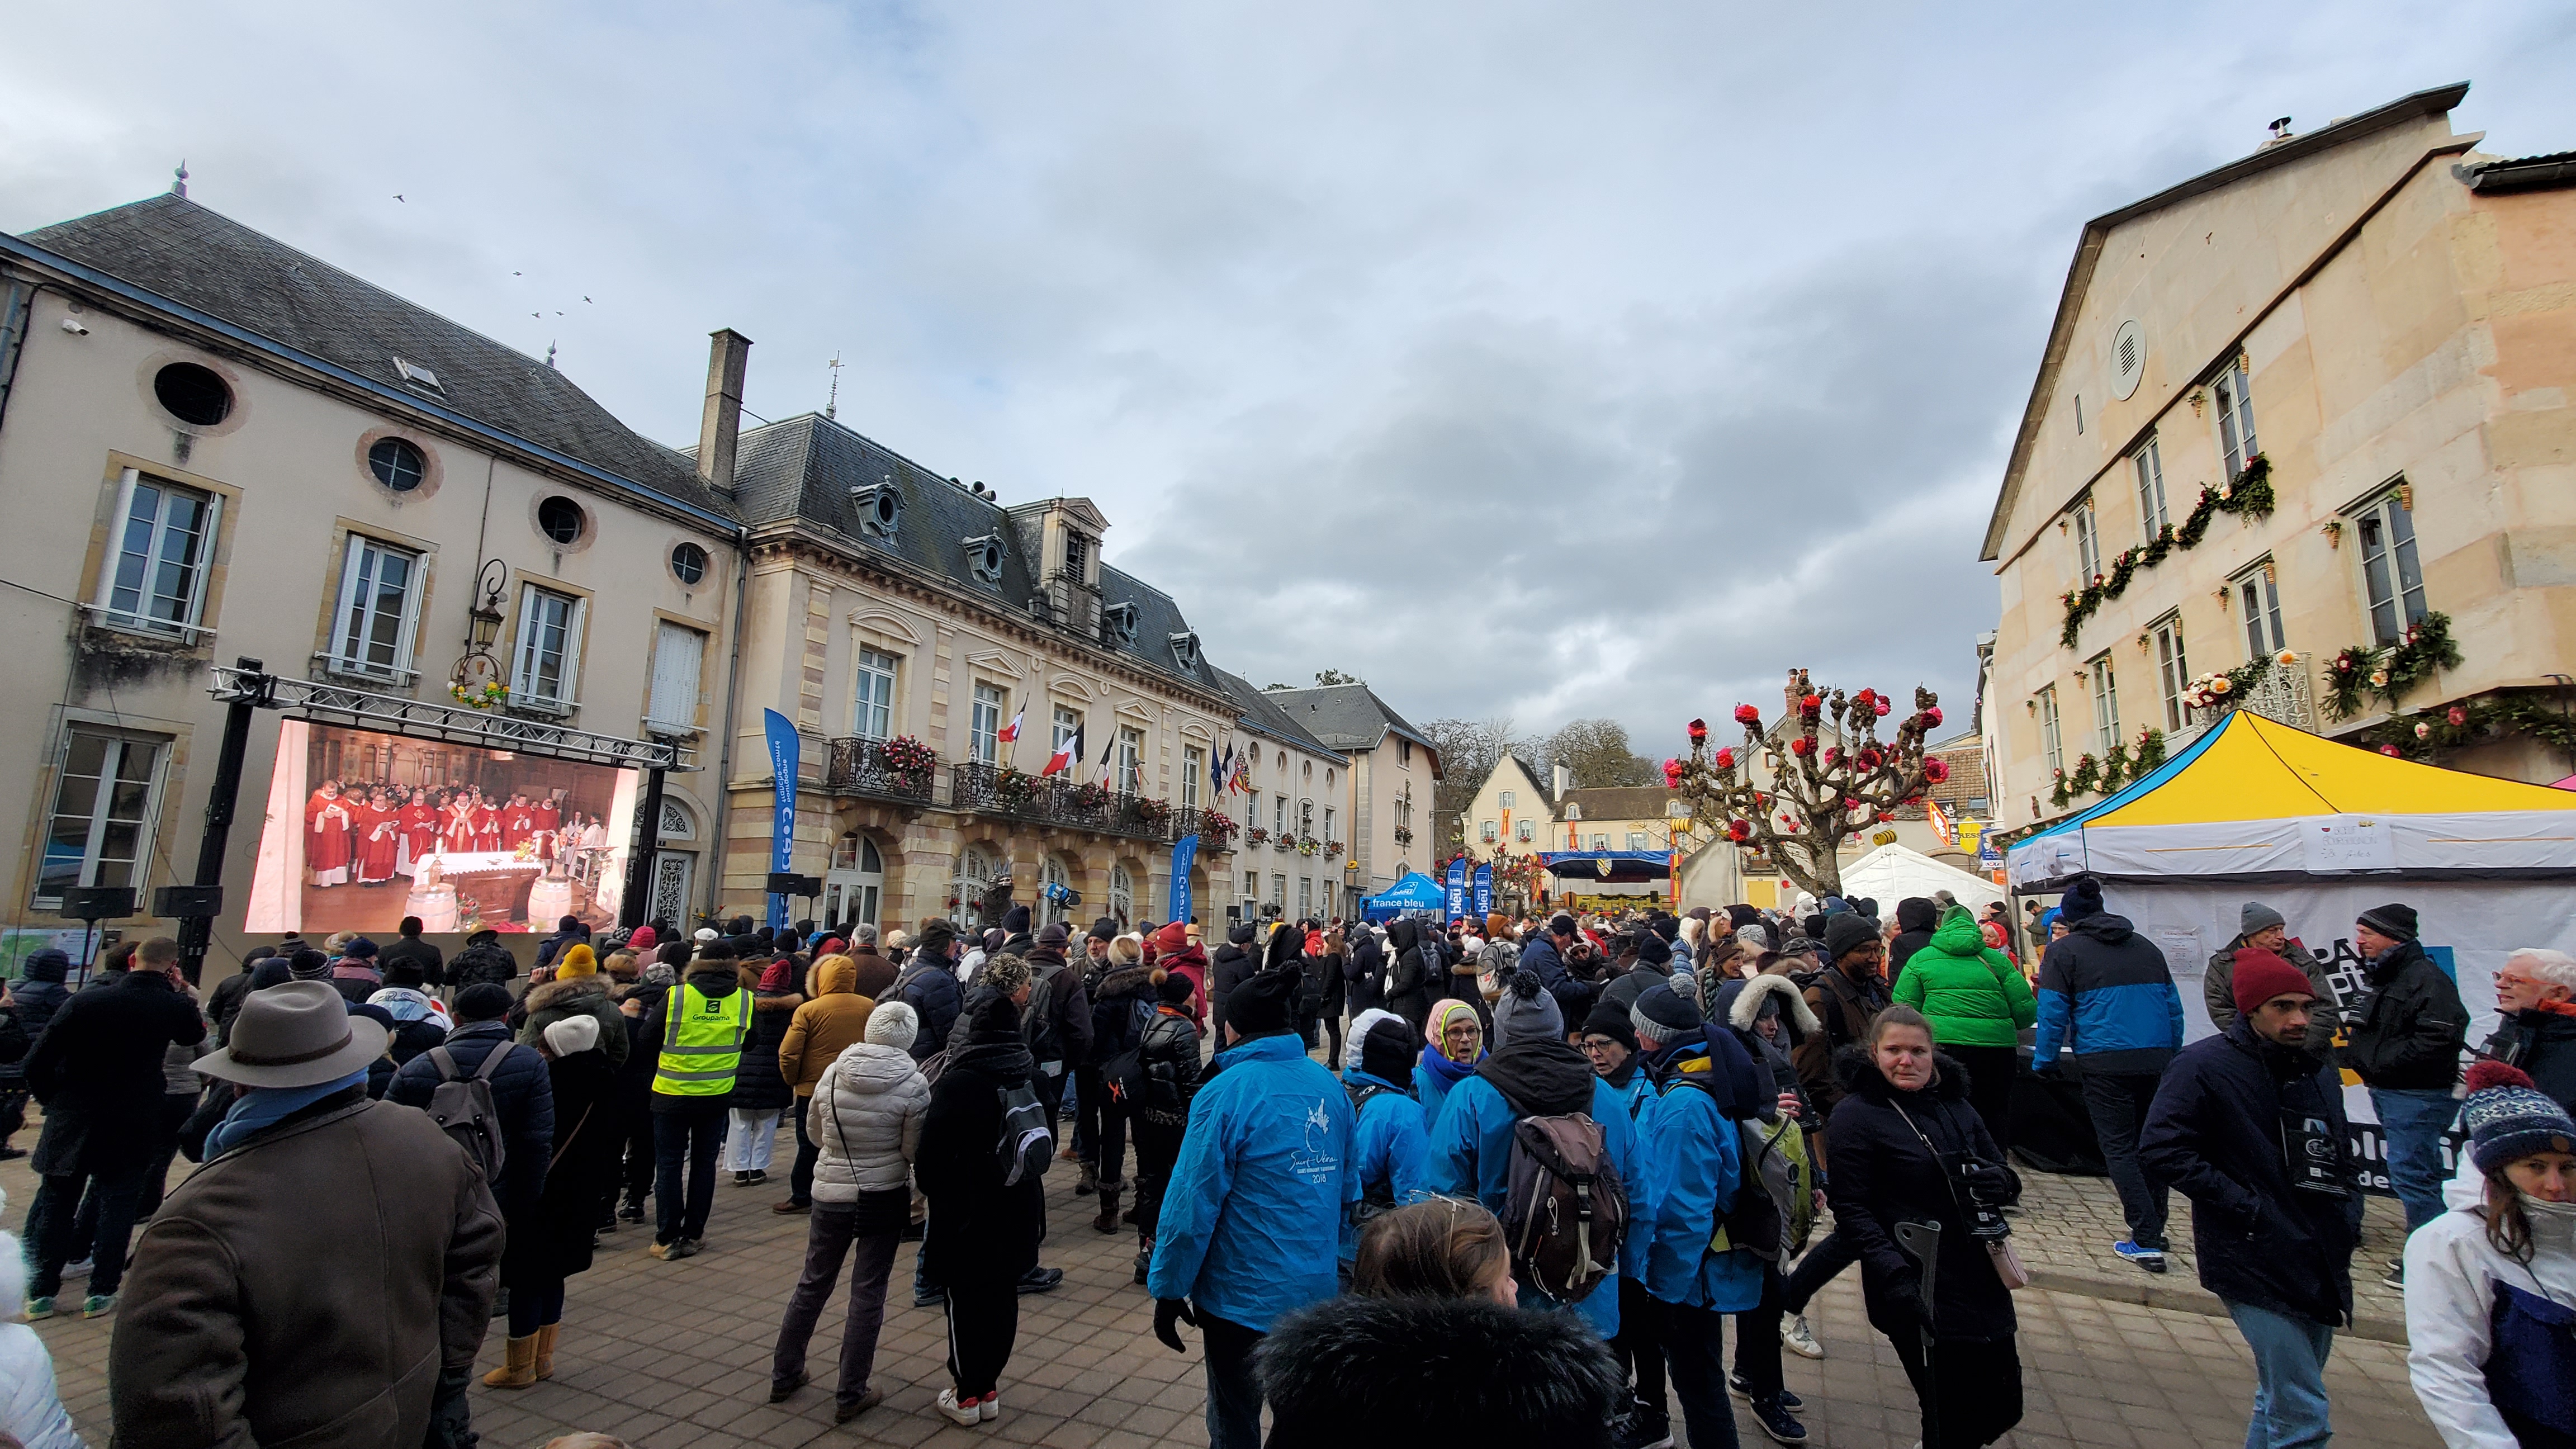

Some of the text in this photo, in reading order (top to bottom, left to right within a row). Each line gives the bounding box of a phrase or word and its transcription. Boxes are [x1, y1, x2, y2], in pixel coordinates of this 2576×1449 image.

[1372, 898, 1424, 907] france bleu
[1450, 888, 1461, 914] bleu
[1478, 889, 1488, 912] bleu
[1312, 1173, 1327, 1183] 2018
